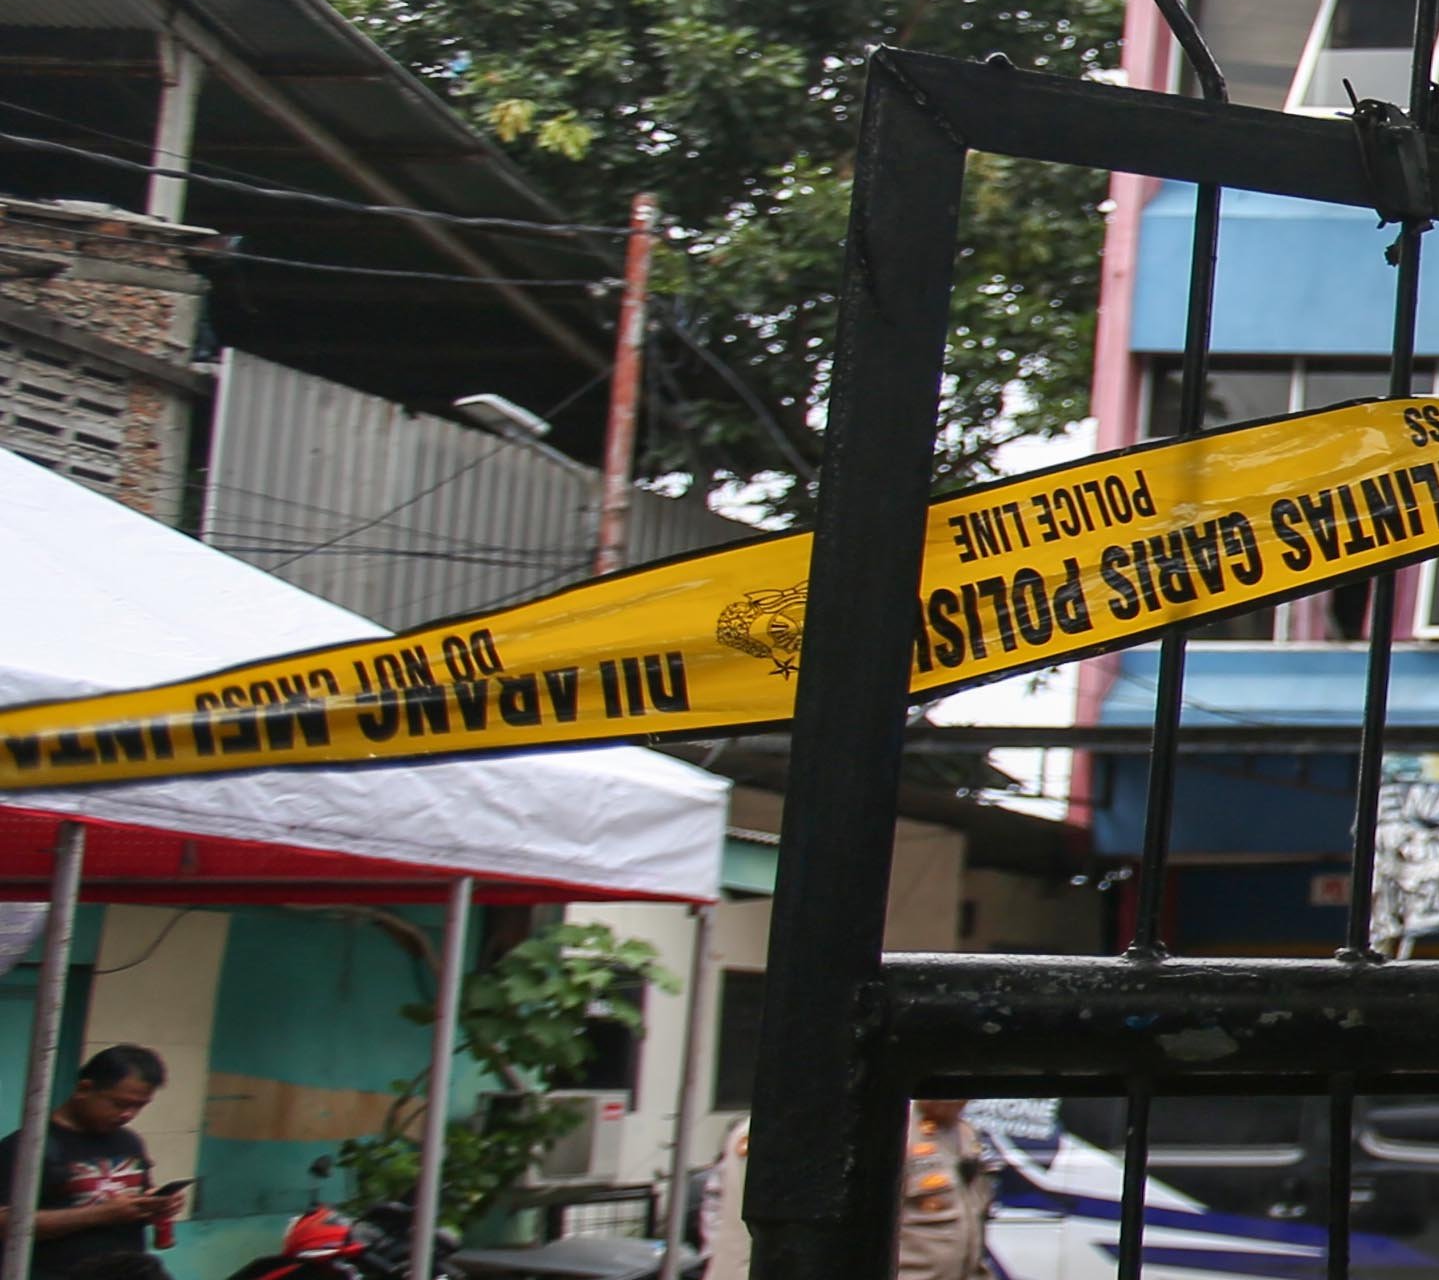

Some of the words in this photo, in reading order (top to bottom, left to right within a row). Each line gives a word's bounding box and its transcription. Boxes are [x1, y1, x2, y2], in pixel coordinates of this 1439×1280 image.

[947, 501, 1032, 564] LINE
[1040, 470, 1157, 543] POLICE
[1100, 511, 1265, 621] GARIS
[912, 556, 1094, 672] POLISI
[443, 627, 504, 682] DO
